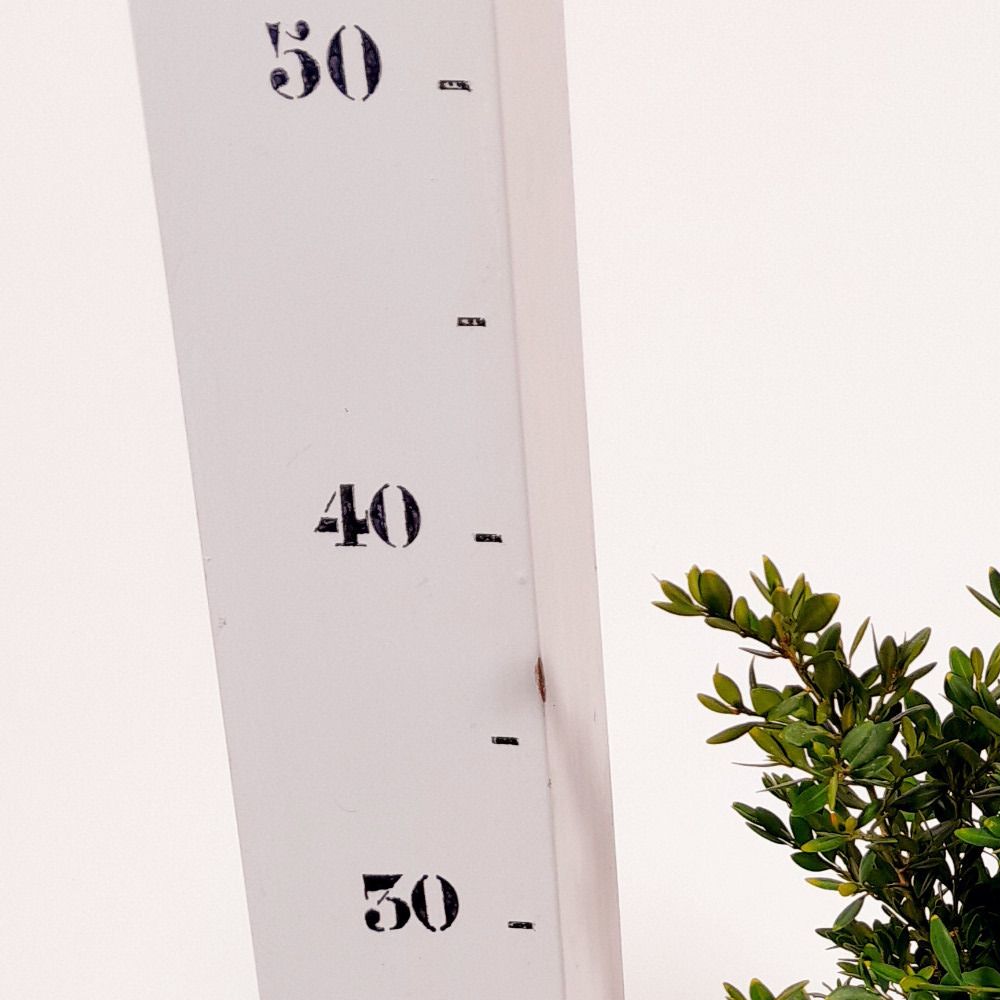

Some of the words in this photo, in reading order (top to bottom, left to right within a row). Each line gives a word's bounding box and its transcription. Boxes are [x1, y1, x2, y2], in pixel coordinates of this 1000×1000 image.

[265, 20, 382, 102] 50
[314, 483, 421, 549] 40
[362, 873, 460, 933] 30
